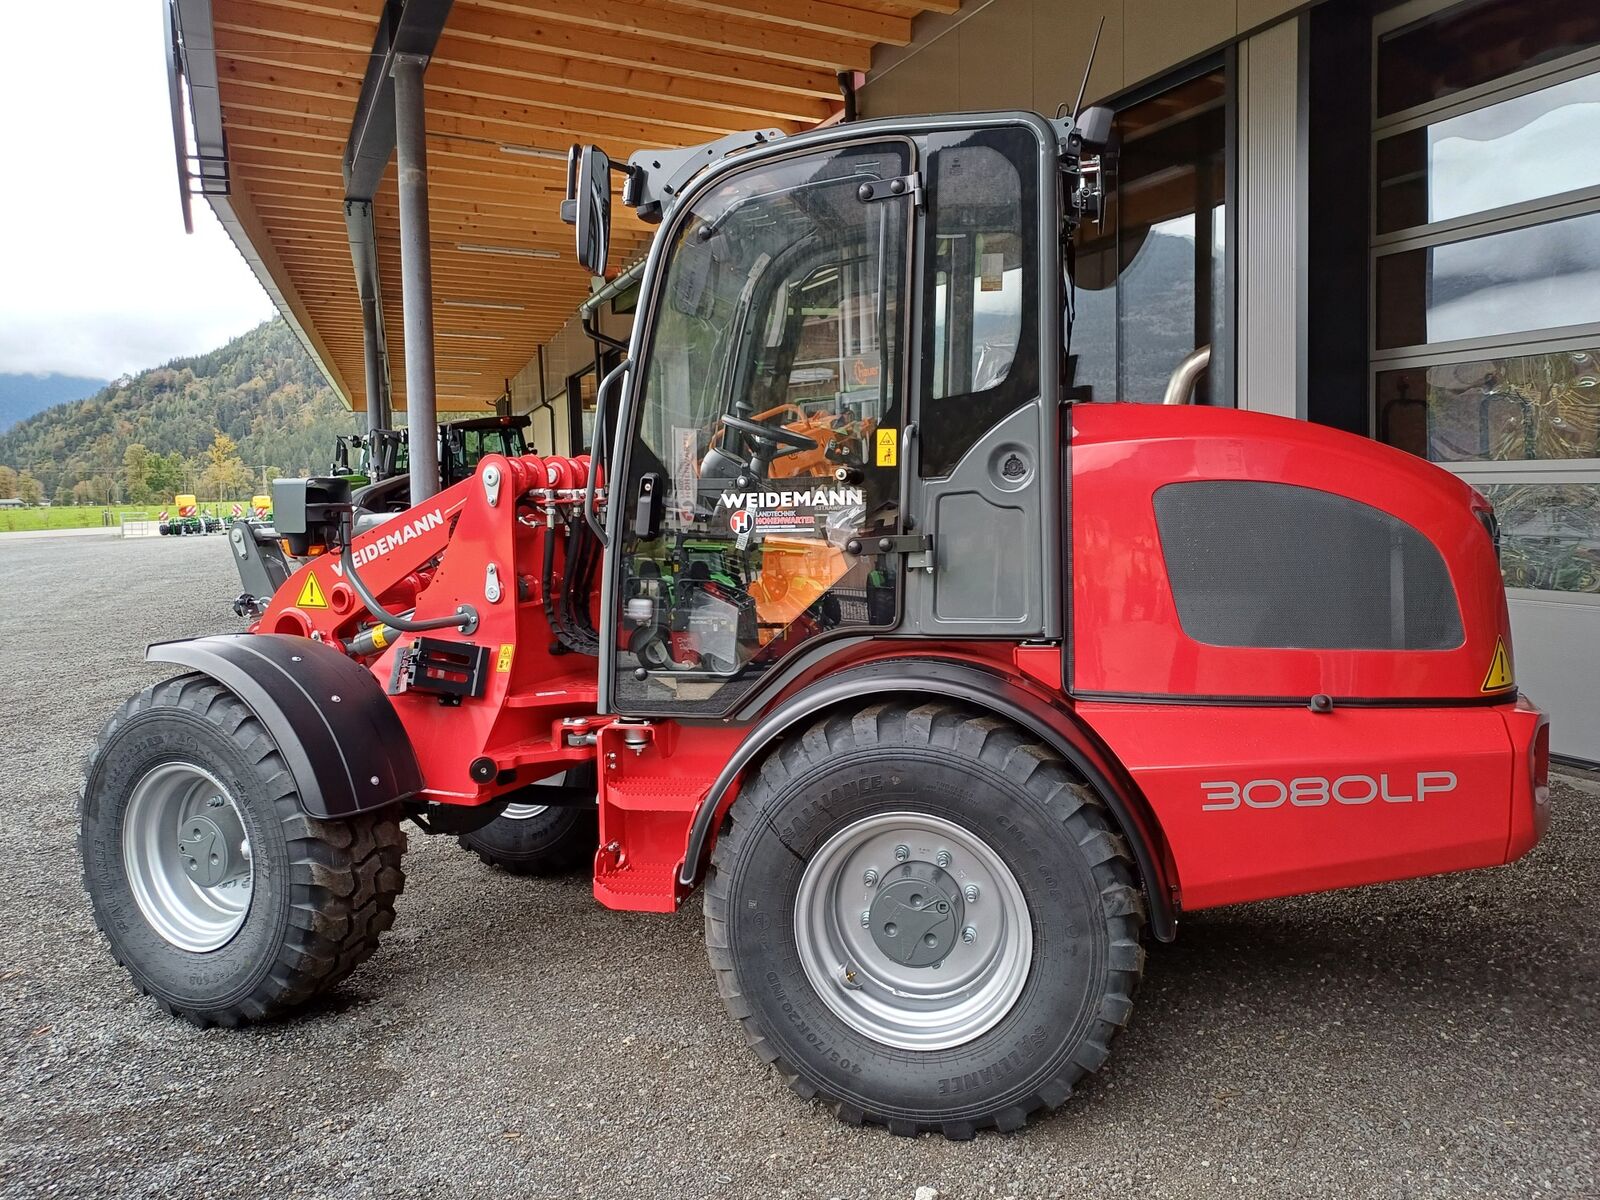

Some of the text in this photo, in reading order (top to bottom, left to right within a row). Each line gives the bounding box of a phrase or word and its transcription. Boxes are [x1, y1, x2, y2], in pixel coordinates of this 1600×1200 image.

[720, 489, 863, 509] WEIDEMANN
[756, 516, 816, 525] HOHENWARTER
[1200, 771, 1457, 811] 3080LP
[790, 773, 884, 840] ALLIANCE
